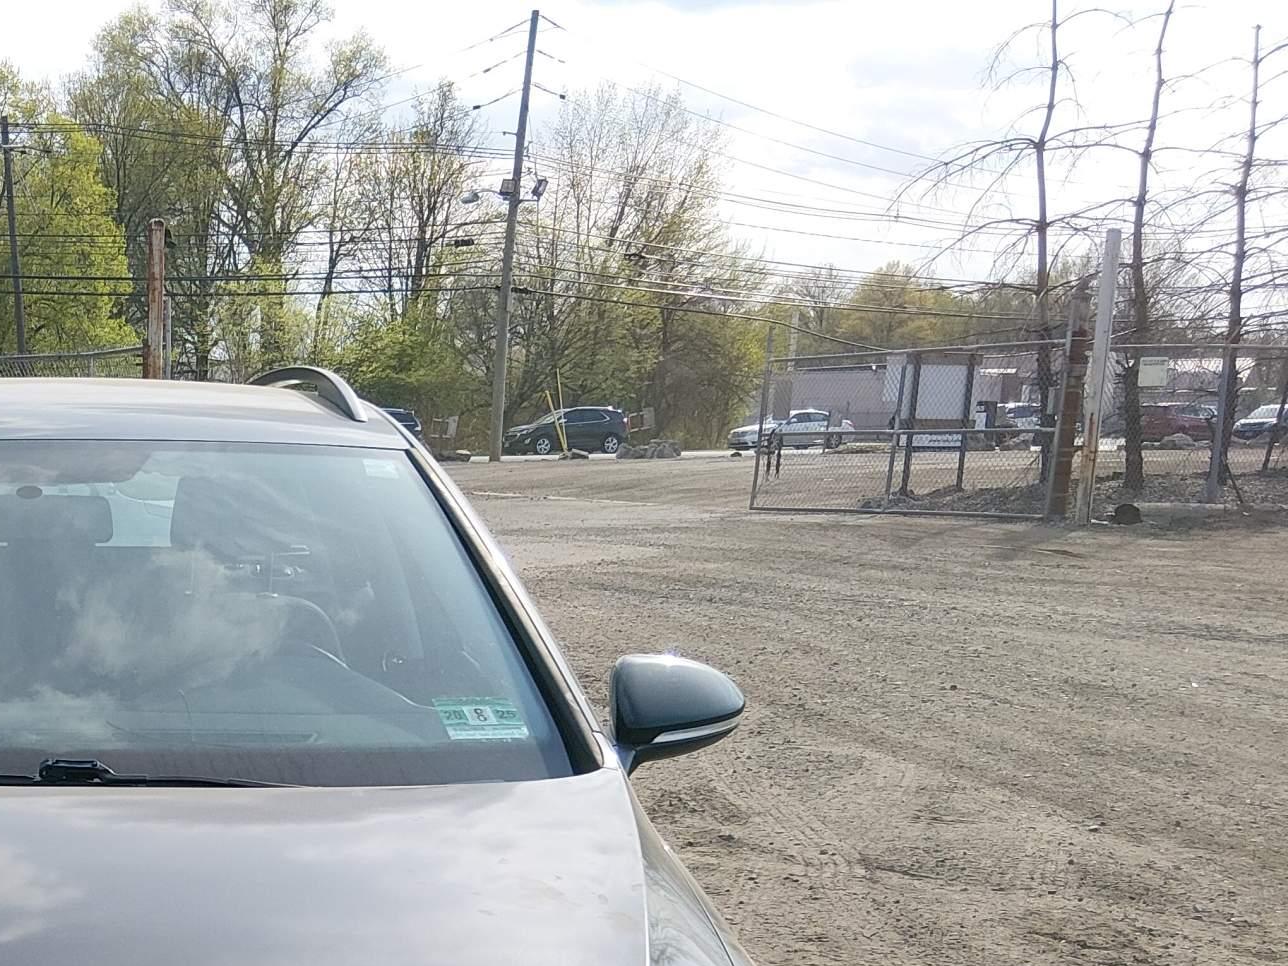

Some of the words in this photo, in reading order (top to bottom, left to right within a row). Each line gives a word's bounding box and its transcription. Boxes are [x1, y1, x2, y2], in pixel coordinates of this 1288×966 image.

[443, 710, 463, 721] 20
[473, 707, 488, 722] 8
[495, 709, 517, 720] 25
